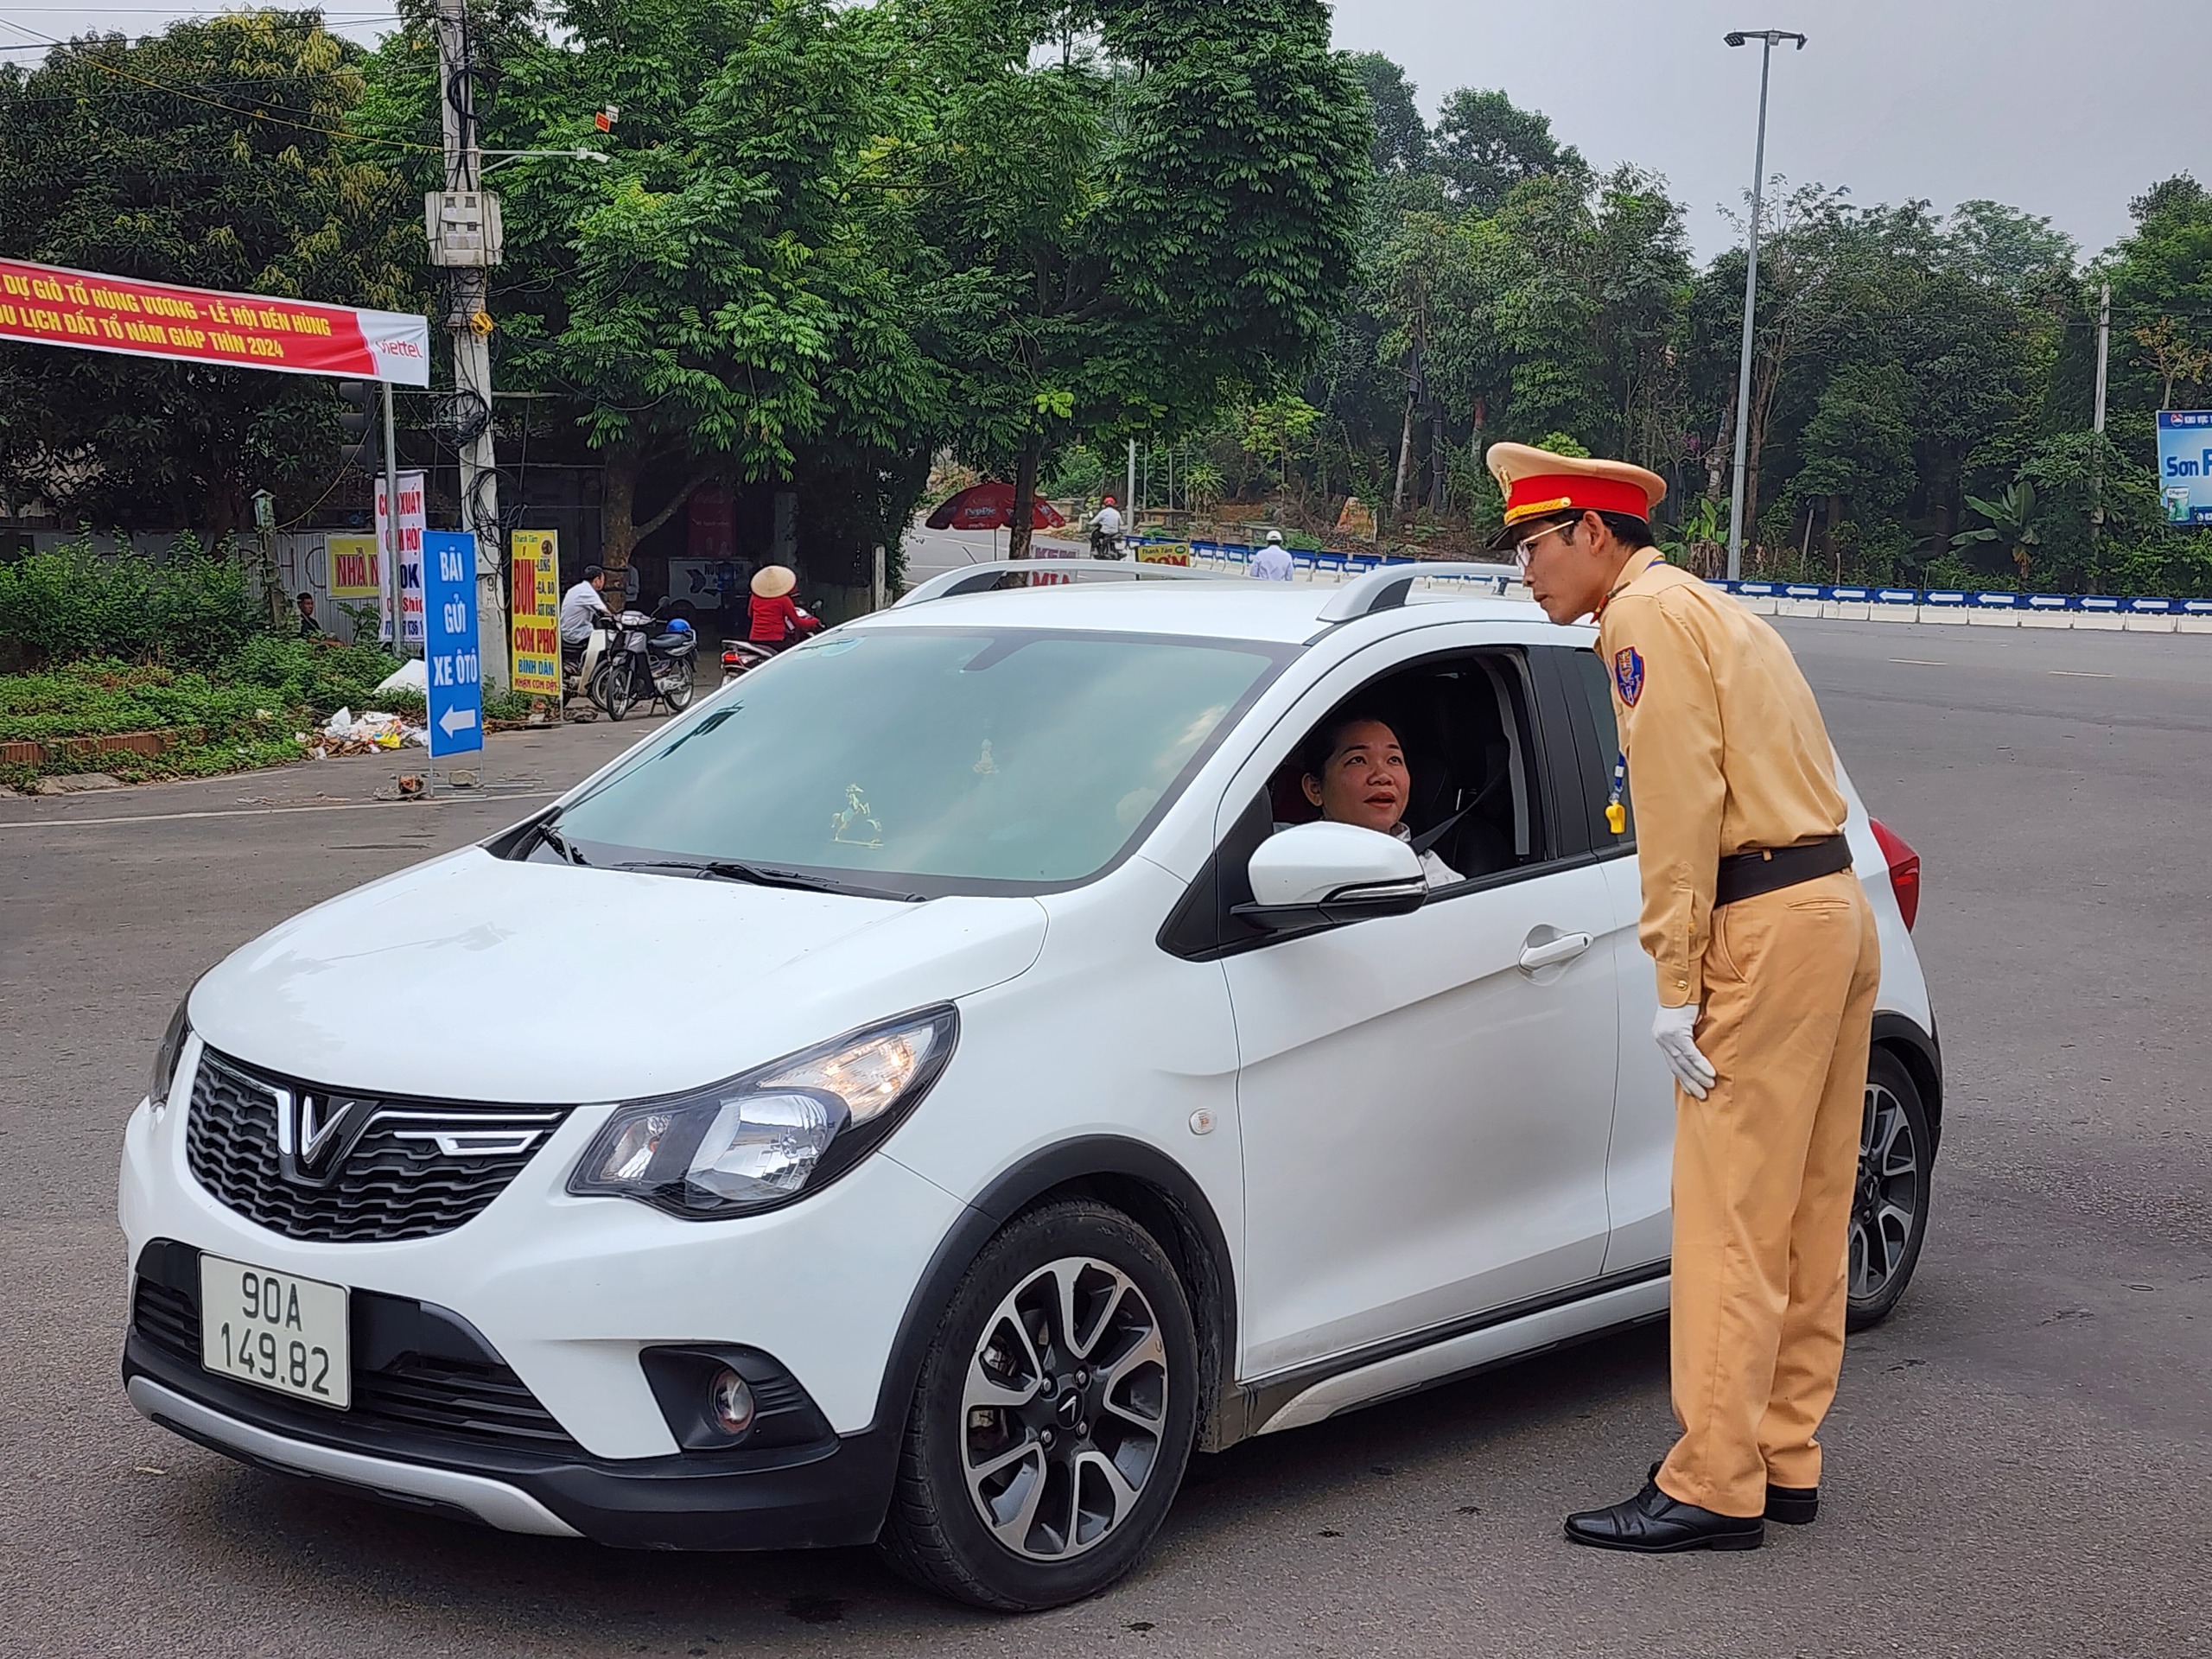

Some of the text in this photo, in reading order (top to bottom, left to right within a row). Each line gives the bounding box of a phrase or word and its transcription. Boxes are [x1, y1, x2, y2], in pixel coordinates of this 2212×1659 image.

[3, 274, 29, 301] DỰ
[32, 275, 64, 302] GIỖ
[65, 279, 89, 306] TỔ
[90, 286, 141, 313] HÙNG
[140, 295, 199, 321] VƯƠNG
[208, 300, 231, 324] LỄ
[230, 305, 259, 332] HỘI
[291, 311, 332, 337] HÙNG
[19, 307, 62, 334] LỊCH
[63, 308, 99, 337] ĐẤT
[99, 313, 124, 340] TỔ
[124, 319, 168, 345] NĂM
[168, 325, 207, 350] GIÁP
[207, 329, 247, 354] THÌN
[247, 337, 284, 359] 2024
[335, 548, 368, 588] NHÀ
[439, 546, 463, 582] BÃI
[443, 593, 467, 633] GỬI
[514, 618, 557, 655] CƠM PHỞ
[433, 647, 478, 686] XE ÔTÔ
[518, 656, 555, 676] BÌNH DÂN
[242, 1271, 302, 1332] 90A
[221, 1322, 330, 1396] 149.82
